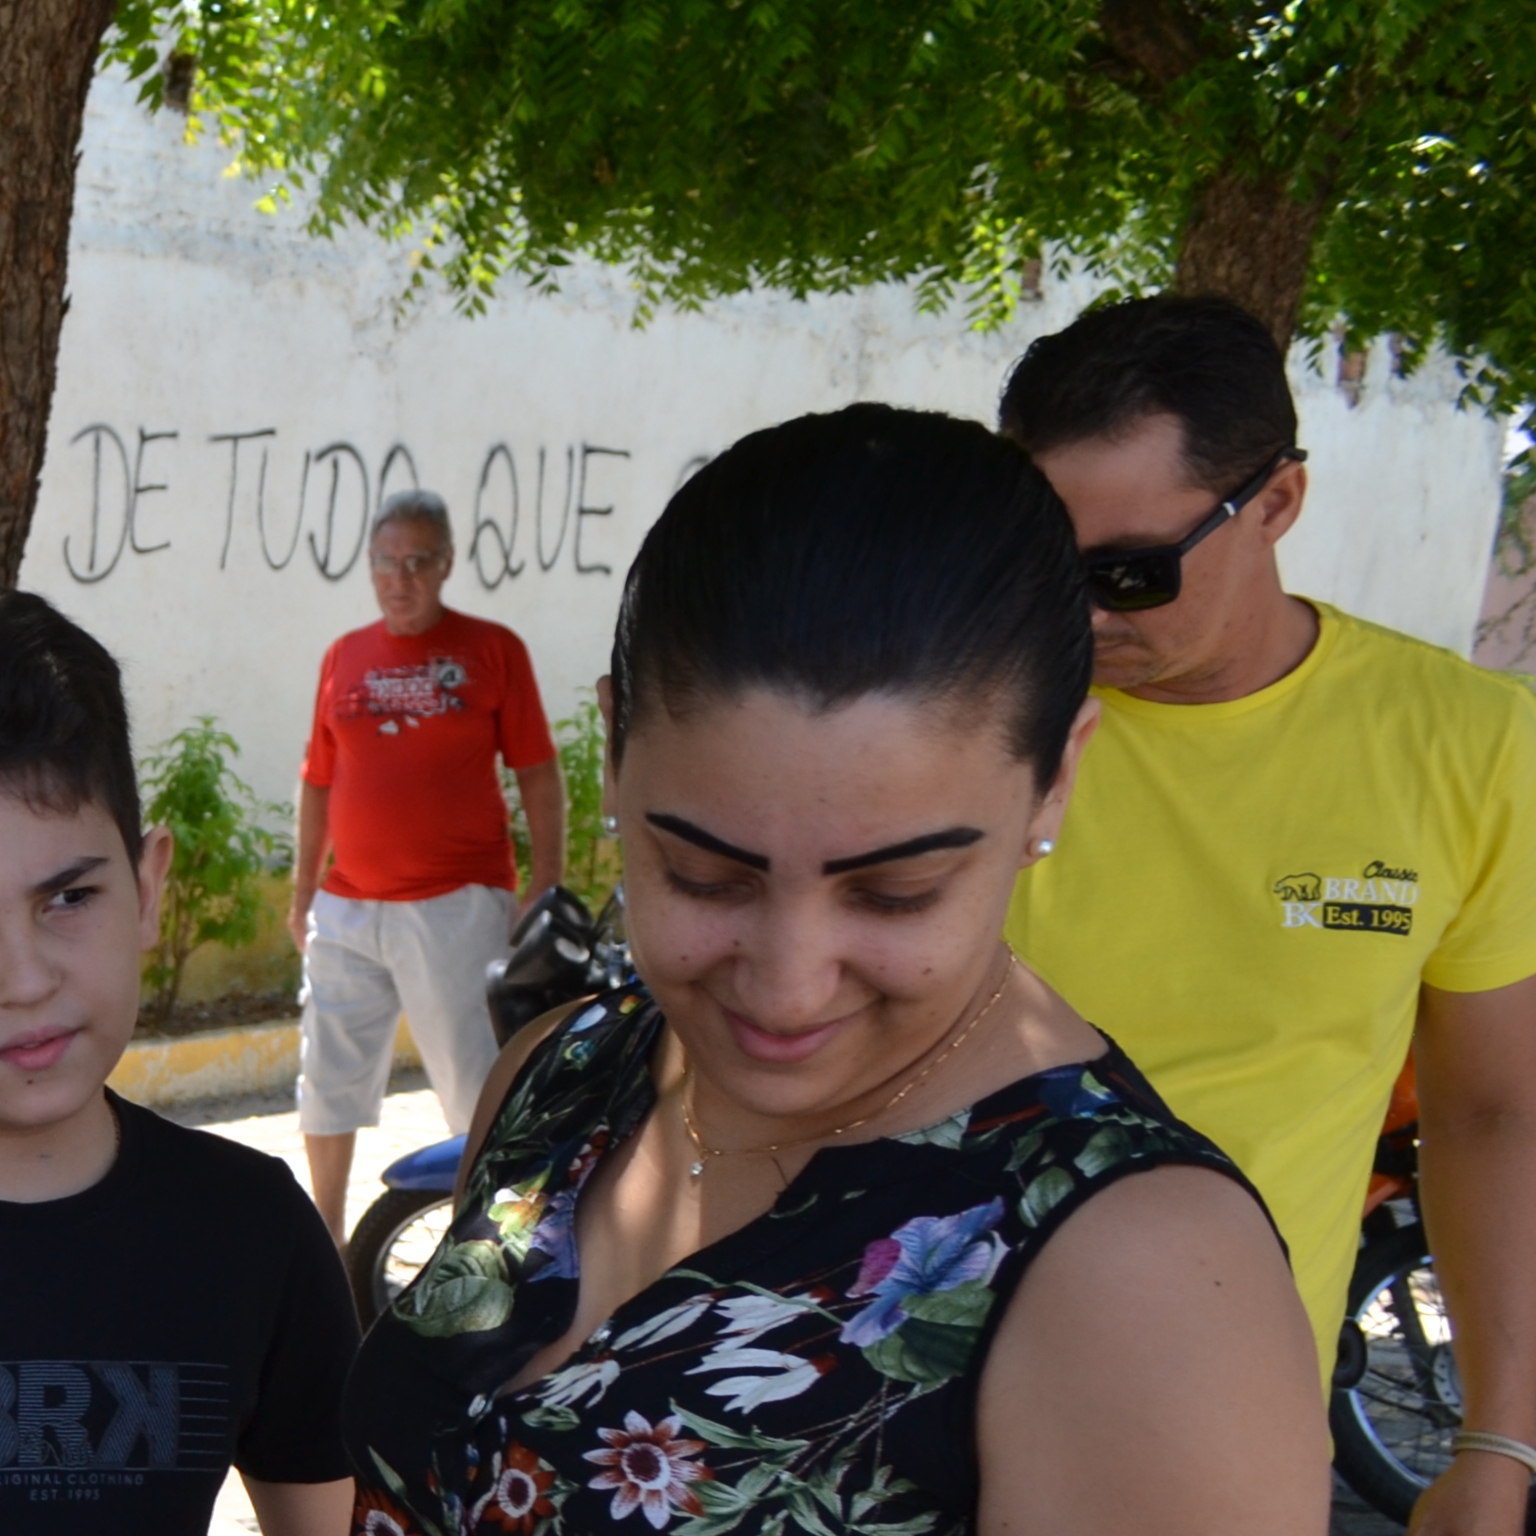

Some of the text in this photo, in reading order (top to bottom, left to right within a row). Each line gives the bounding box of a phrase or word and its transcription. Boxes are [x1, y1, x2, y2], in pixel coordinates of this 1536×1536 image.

[63, 423, 179, 584] DE
[467, 442, 631, 590] QUE
[1323, 876, 1420, 907] BRAND
[67, 1473, 145, 1486] CLOTHING
[67, 1488, 101, 1501] 1995
